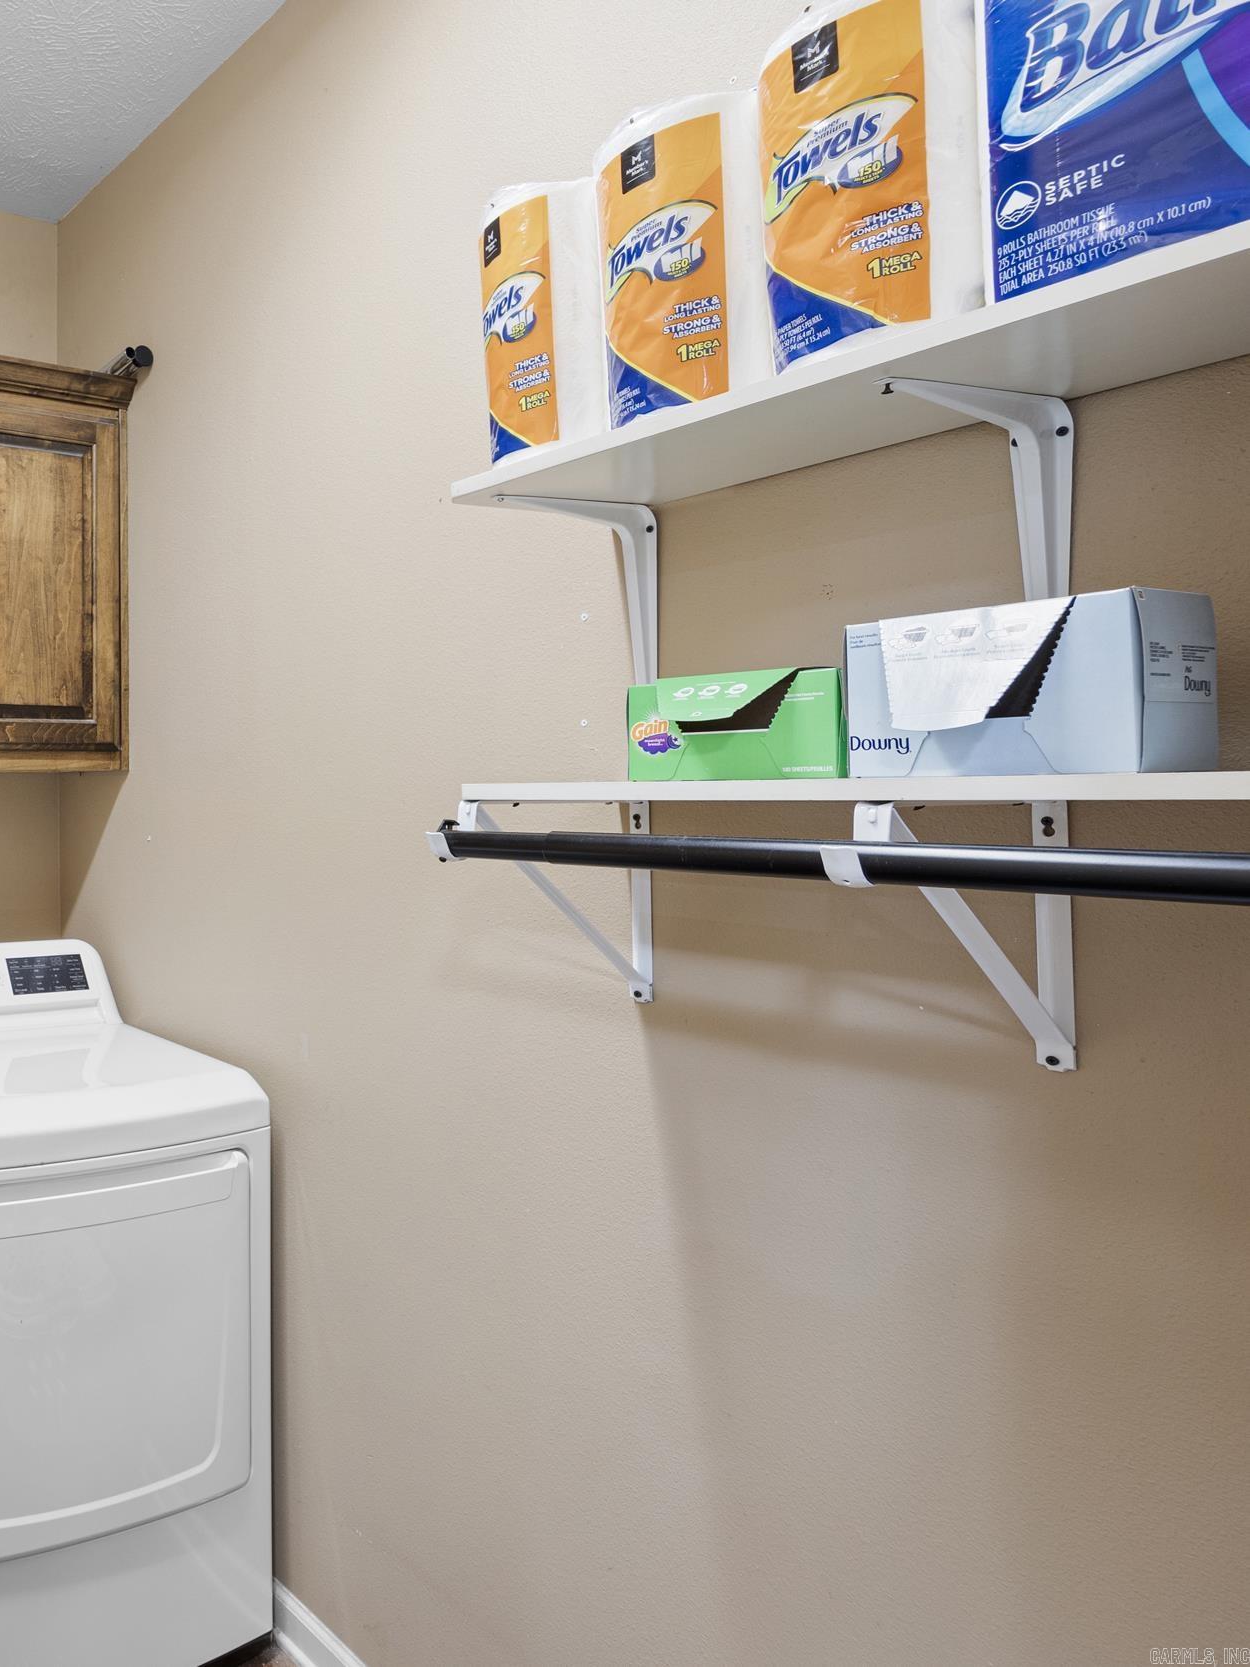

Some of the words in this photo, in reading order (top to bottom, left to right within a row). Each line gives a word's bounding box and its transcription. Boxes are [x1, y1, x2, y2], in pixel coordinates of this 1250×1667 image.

[772, 112, 882, 205] Towels
[858, 160, 882, 177] 150
[1045, 154, 1125, 194] SEPTIC
[1045, 174, 1104, 206] SAFE
[851, 223, 878, 238] LONG
[880, 210, 923, 227] LASTING
[863, 204, 908, 226] THICK
[911, 202, 922, 211] &
[851, 225, 909, 250] STRONG
[911, 222, 922, 232] &
[998, 248, 1002, 259] 9
[1003, 236, 1026, 256] ROLLS
[1027, 216, 1079, 244] BATHROOM
[1082, 203, 1115, 224] TISSUE
[999, 266, 1016, 283] EACH
[1018, 255, 1044, 274] SHEET
[1066, 242, 1076, 256] IN
[1079, 239, 1086, 250] X
[1096, 232, 1107, 244] IN
[1111, 221, 1135, 240] (10.8
[1138, 216, 1154, 230] cm
[1157, 211, 1164, 223] X
[1167, 204, 1186, 220] 10.1
[1189, 196, 1212, 212] cm)
[608, 214, 688, 288] Towels
[862, 232, 922, 254] ABSORBENT
[1010, 246, 1034, 265] 2-PLY
[1035, 234, 1068, 254] SHEETS
[1070, 224, 1090, 241] PER
[670, 258, 690, 272] 150
[868, 258, 880, 278] 1
[882, 252, 921, 267] MEGA
[882, 262, 915, 276] ROLL
[1000, 278, 1020, 296] TOTAL
[1021, 268, 1045, 286] AREA
[1048, 258, 1073, 276] 250.8
[1075, 252, 1086, 266] SQ
[1088, 247, 1100, 261] FT
[664, 312, 685, 322] LONG
[687, 304, 721, 316] LASTING
[674, 298, 710, 313] THICK
[711, 296, 720, 304] &
[663, 316, 710, 334] STRONG
[712, 314, 720, 322] &
[673, 322, 722, 338] ABSORBENT
[677, 344, 688, 362] 1
[688, 339, 720, 352] MEGA
[688, 348, 716, 360] ROLL
[515, 355, 541, 370] THICK
[509, 371, 542, 388] STRONG
[543, 369, 550, 377] &
[519, 396, 527, 412] 1
[527, 390, 550, 402] MEGA
[527, 399, 547, 410] ROLL
[1184, 676, 1211, 696] Downy
[631, 719, 669, 742] Gain
[850, 736, 910, 755] Downy
